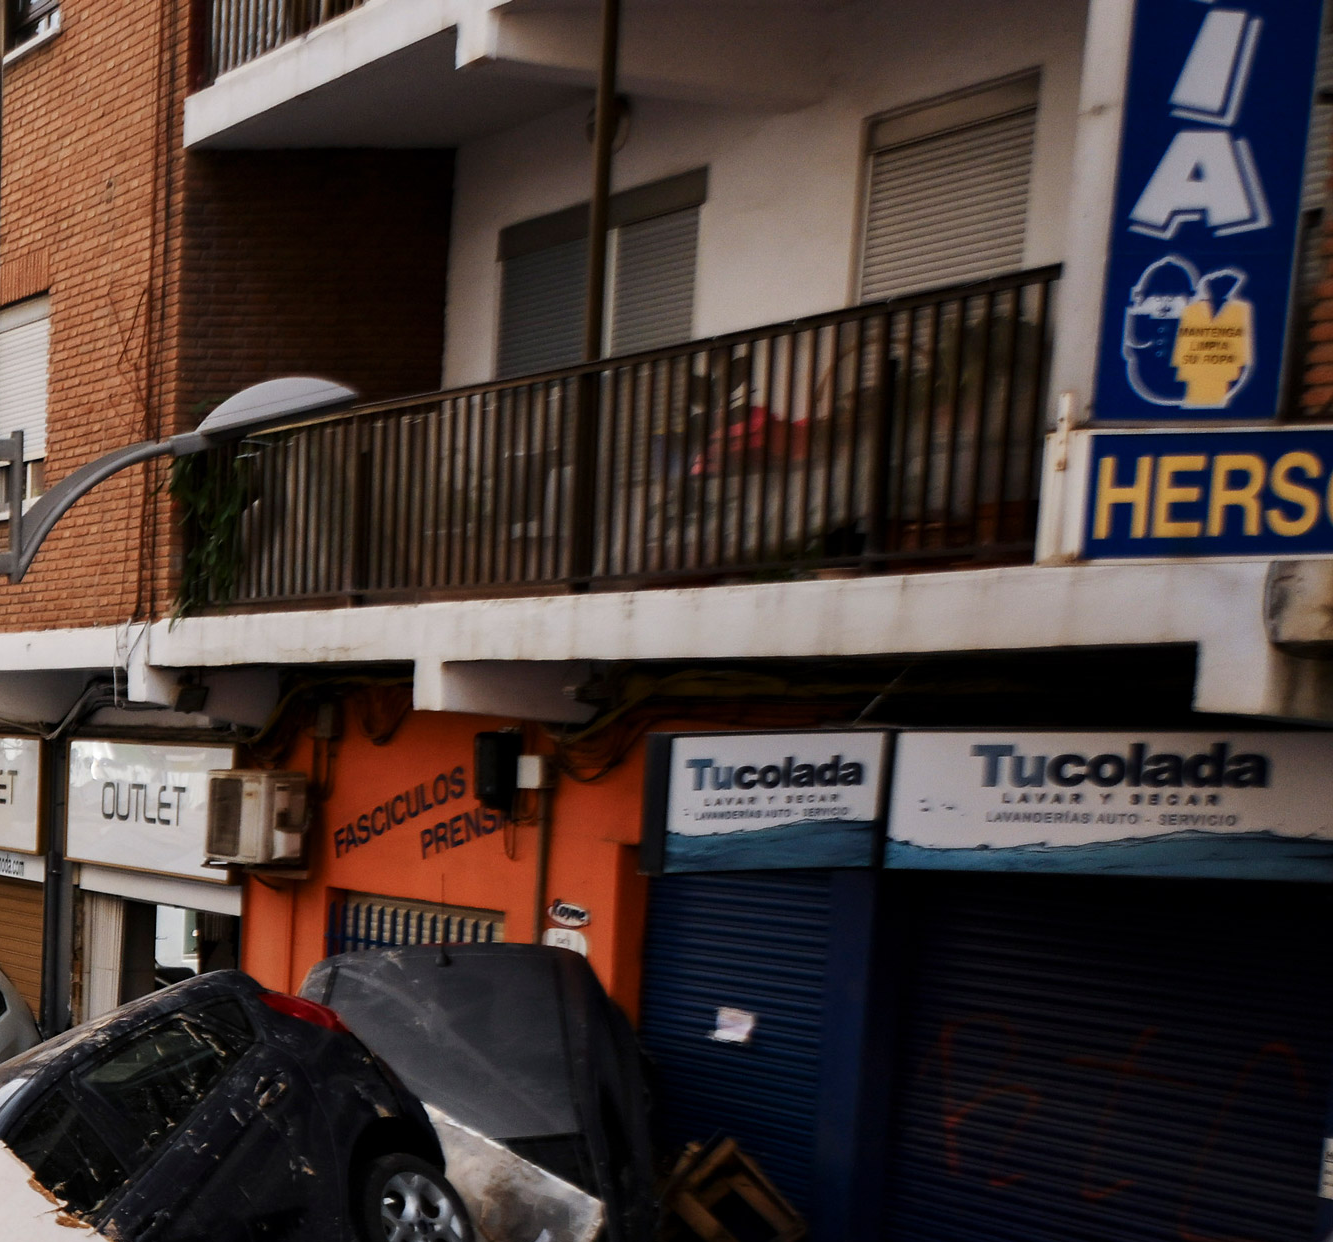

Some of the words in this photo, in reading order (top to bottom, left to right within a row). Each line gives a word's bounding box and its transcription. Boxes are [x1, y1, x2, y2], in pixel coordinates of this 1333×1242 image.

[1127, 0, 1274, 241] IA
[1092, 450, 1333, 540] HERS
[686, 755, 863, 791] Tucolada
[970, 742, 1271, 788] Tucolada
[101, 782, 186, 826] OUTLET
[334, 766, 466, 858] FASCICULOS
[703, 795, 756, 807] LAVAR
[767, 796, 776, 805] Y
[784, 793, 839, 804] SECAR
[764, 808, 791, 818] AUTO
[802, 806, 849, 817] SERVICIO
[1001, 793, 1083, 804] LAVAR
[1100, 793, 1113, 804] Y
[1129, 793, 1221, 806] SECAR
[1096, 813, 1138, 826] AUTO
[1157, 813, 1239, 827] SERVICIO
[420, 807, 504, 860] PRENS
